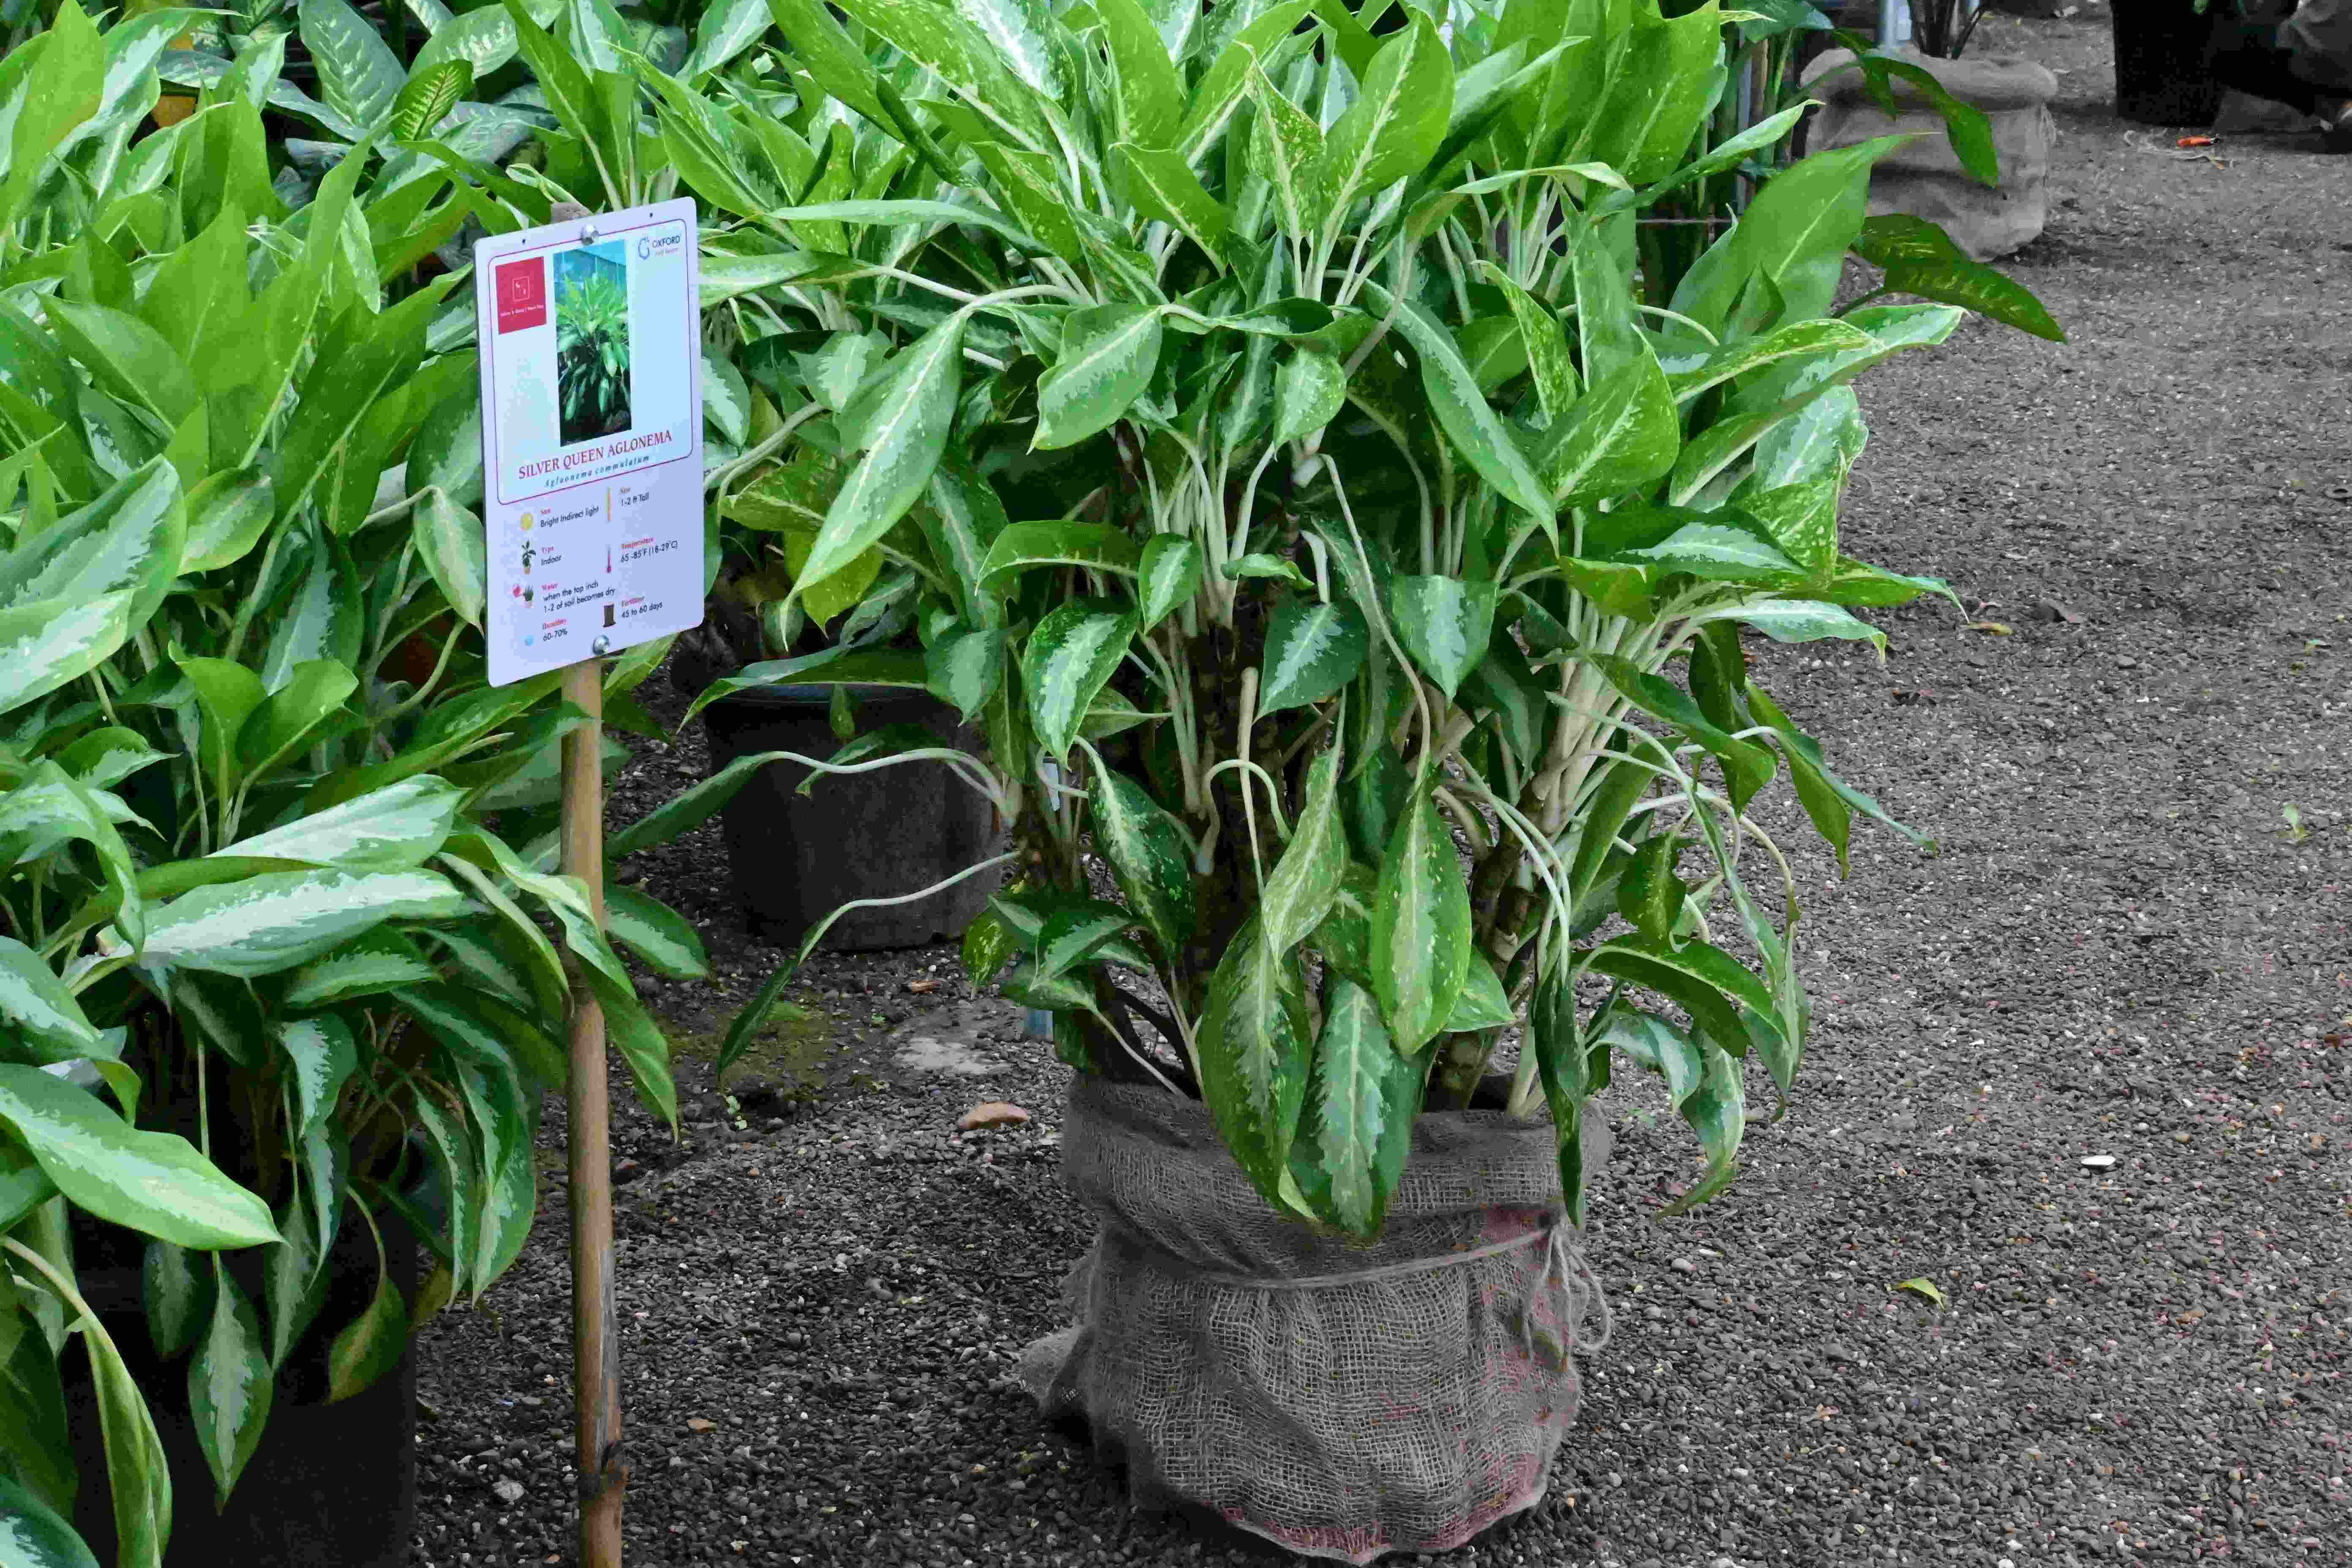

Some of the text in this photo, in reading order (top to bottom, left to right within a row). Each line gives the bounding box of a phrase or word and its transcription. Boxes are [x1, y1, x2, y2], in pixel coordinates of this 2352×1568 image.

[652, 235, 680, 248] OXFORD
[519, 430, 672, 479] SILVER QUEEN AGLONEMA
[621, 496, 631, 506] 1-2
[639, 492, 649, 501] Tall
[540, 504, 599, 528] Bright Indirect light
[541, 555, 562, 566] Indoor
[621, 553, 629, 563] 65
[544, 578, 599, 601] when the top inch
[544, 586, 615, 613] 1-2 of soil becomes dry
[621, 610, 629, 619] 45
[639, 604, 648, 614] 60
[649, 601, 663, 611] days
[543, 628, 568, 642] 60-70%
